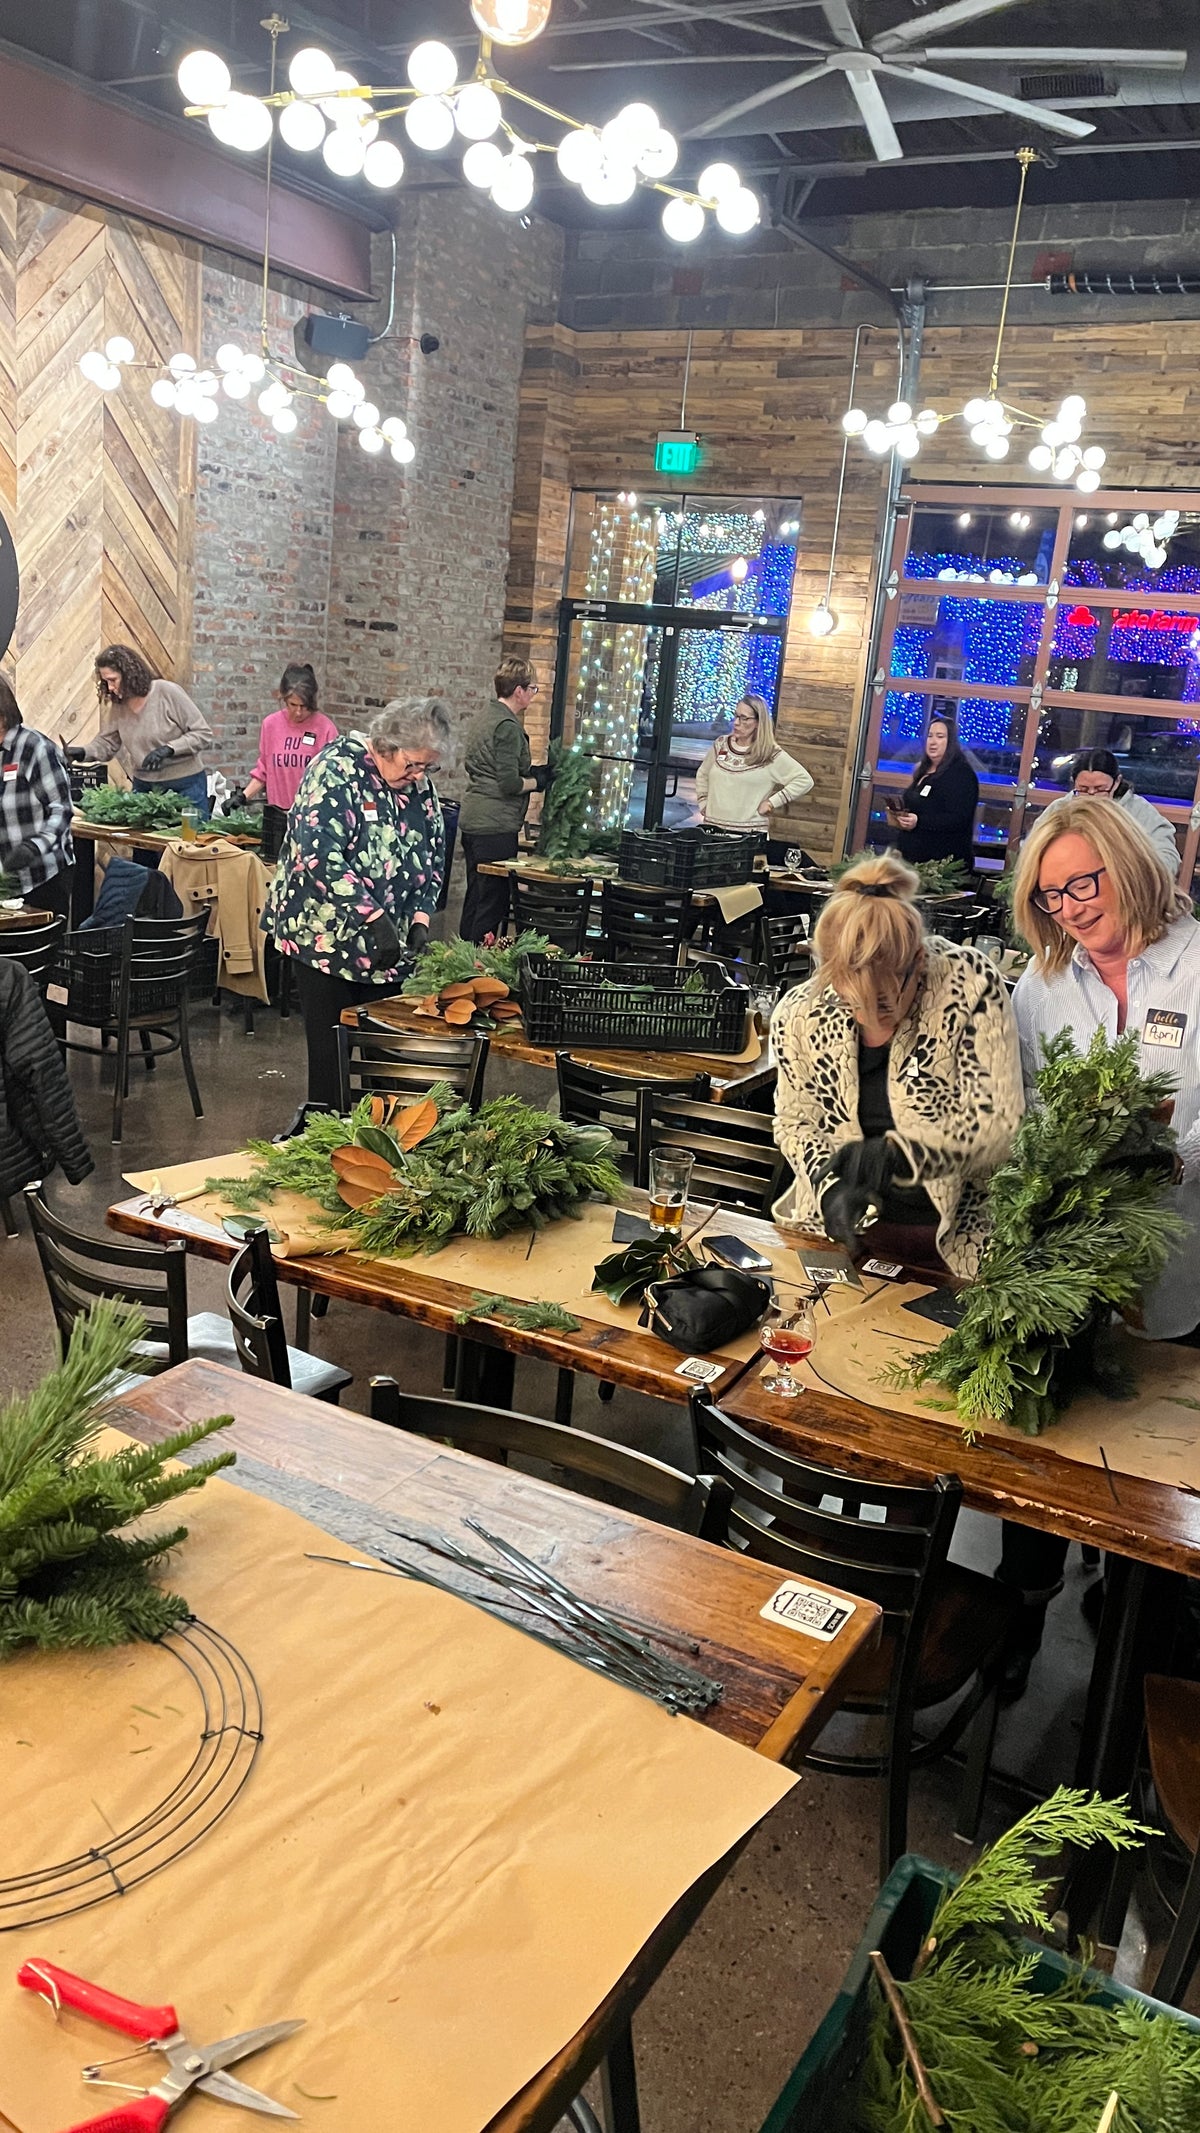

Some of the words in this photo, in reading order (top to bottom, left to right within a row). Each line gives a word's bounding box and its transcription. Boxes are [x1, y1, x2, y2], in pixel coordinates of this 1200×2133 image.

[662, 444, 692, 471] EXIT
[284, 737, 301, 750] AU
[1153, 1011, 1178, 1025] hello
[1149, 1025, 1179, 1043] April
